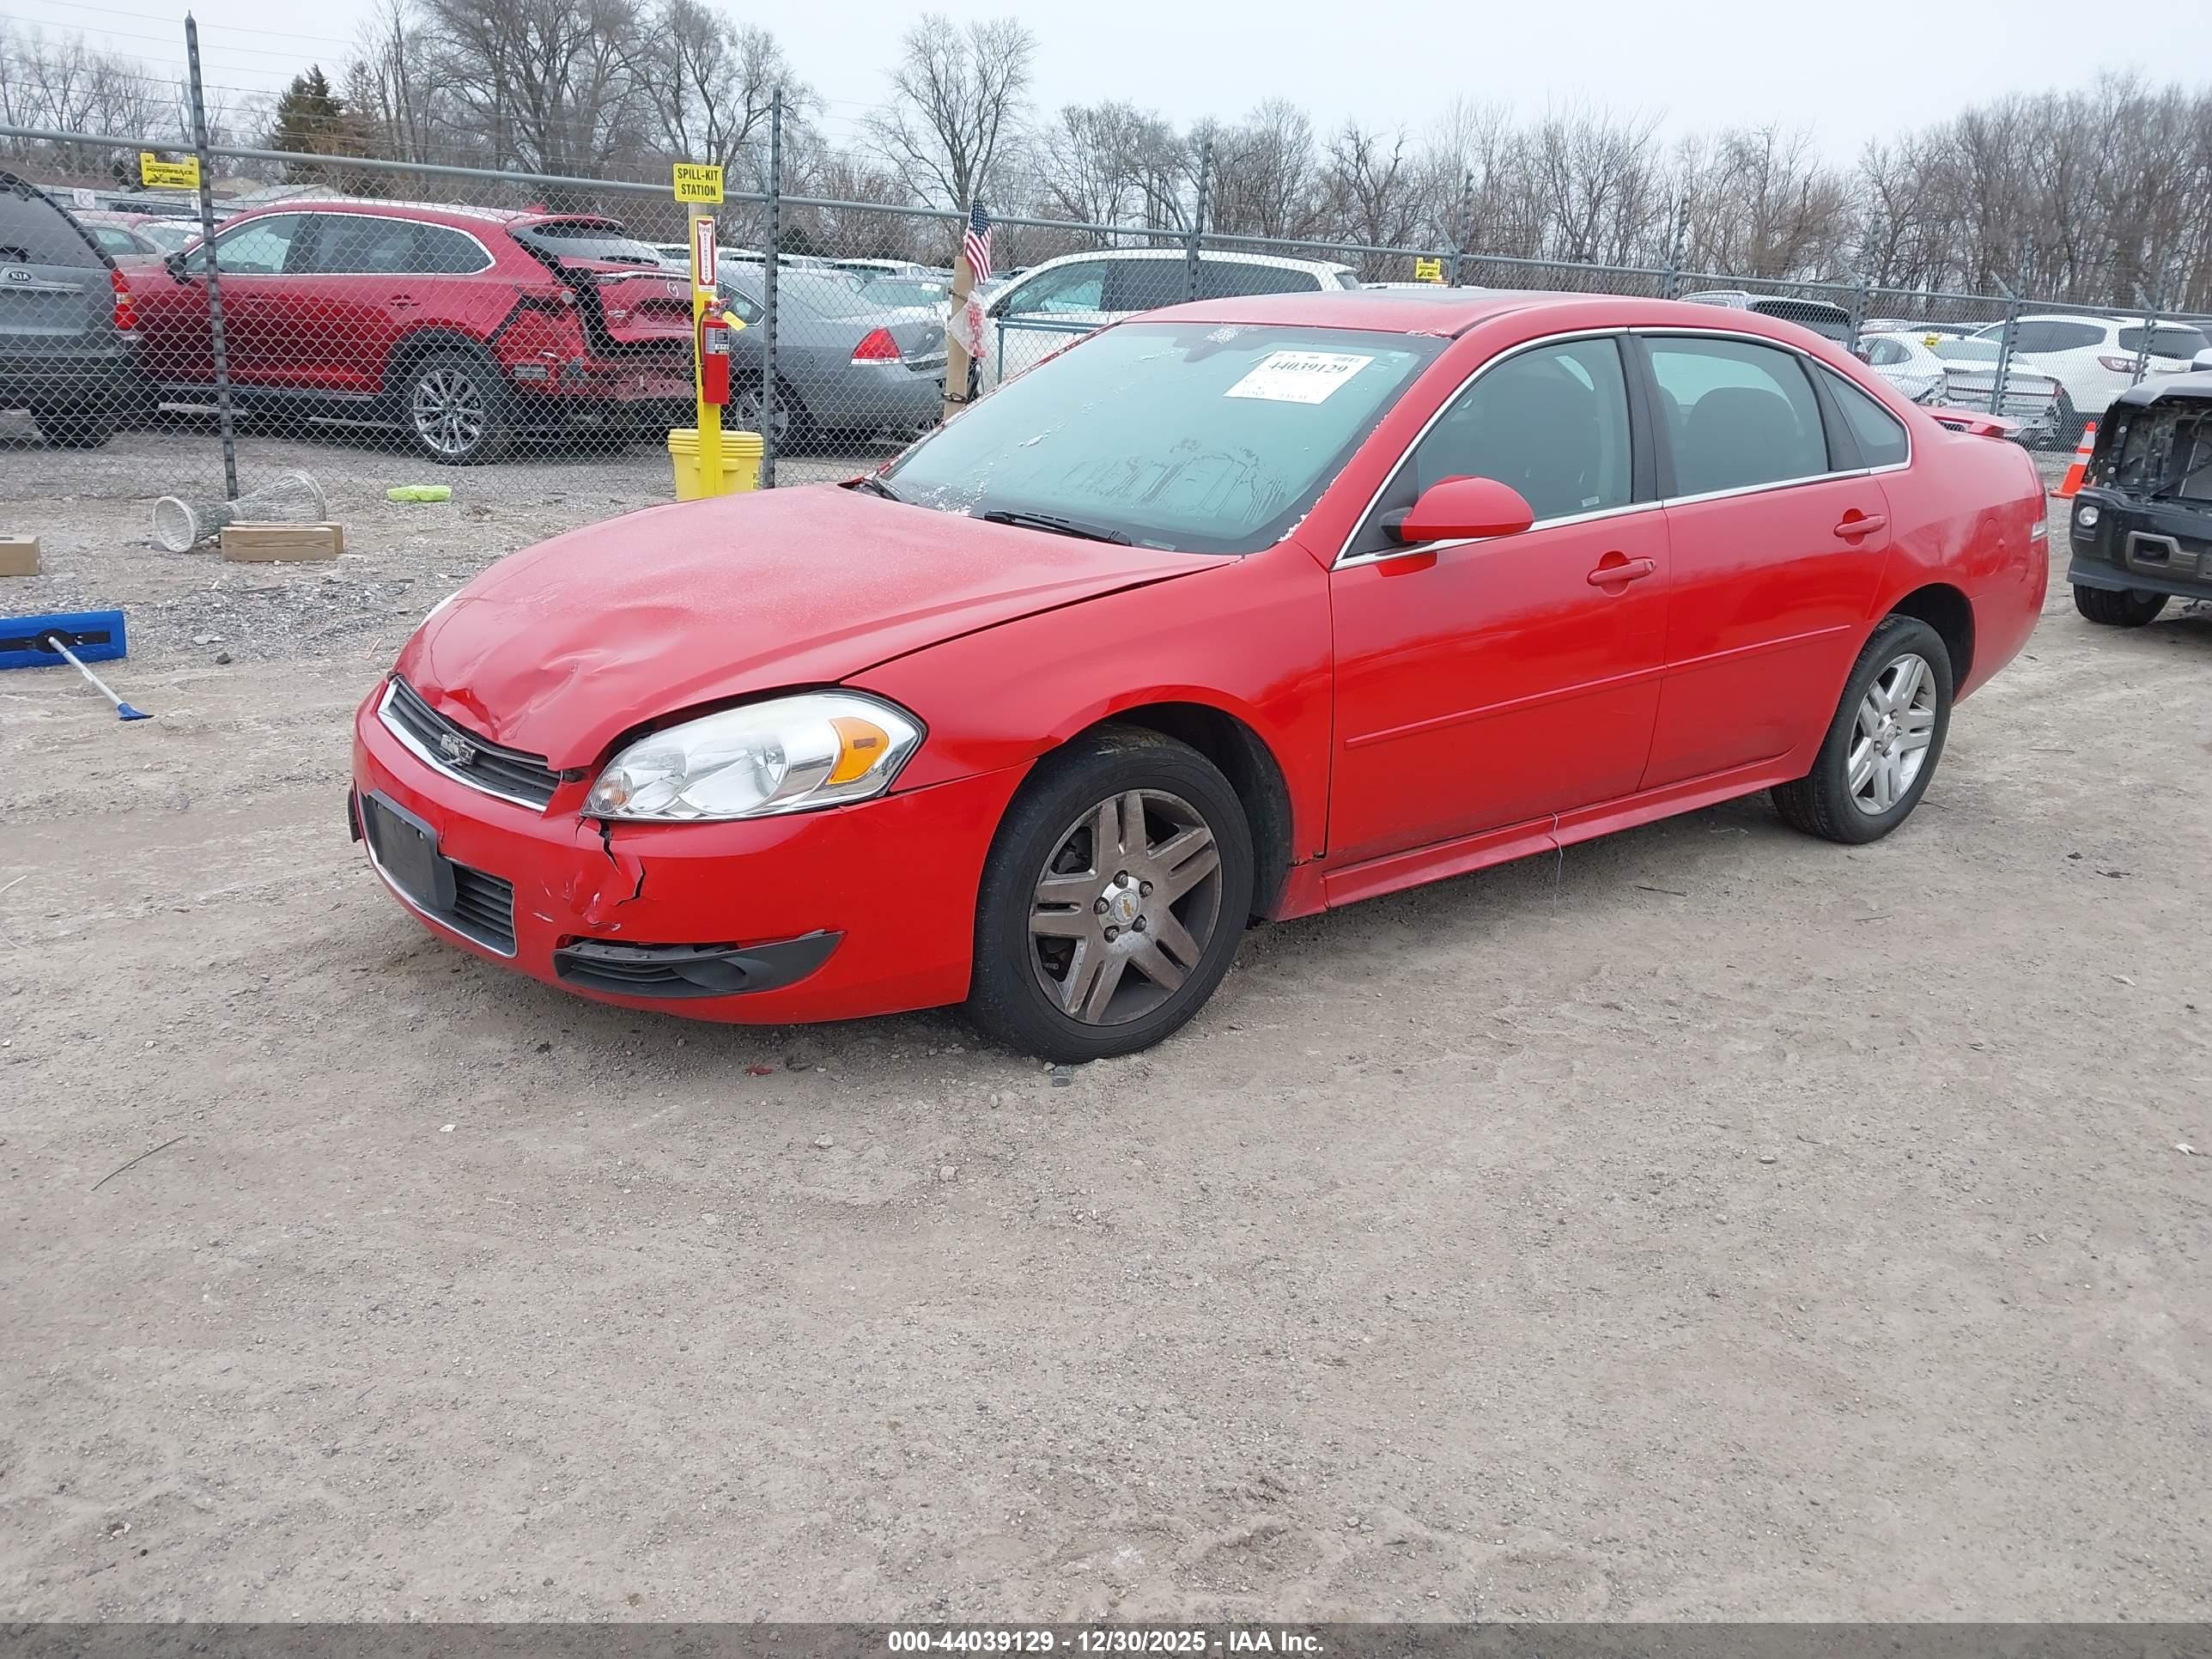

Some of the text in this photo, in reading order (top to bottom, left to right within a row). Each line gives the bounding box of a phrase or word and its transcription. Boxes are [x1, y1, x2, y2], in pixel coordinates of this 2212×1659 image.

[678, 167, 719, 181] SPILL-KIT
[681, 183, 716, 197] STATION
[10, 272, 30, 281] KIA
[1268, 361, 1349, 374] 44039129
